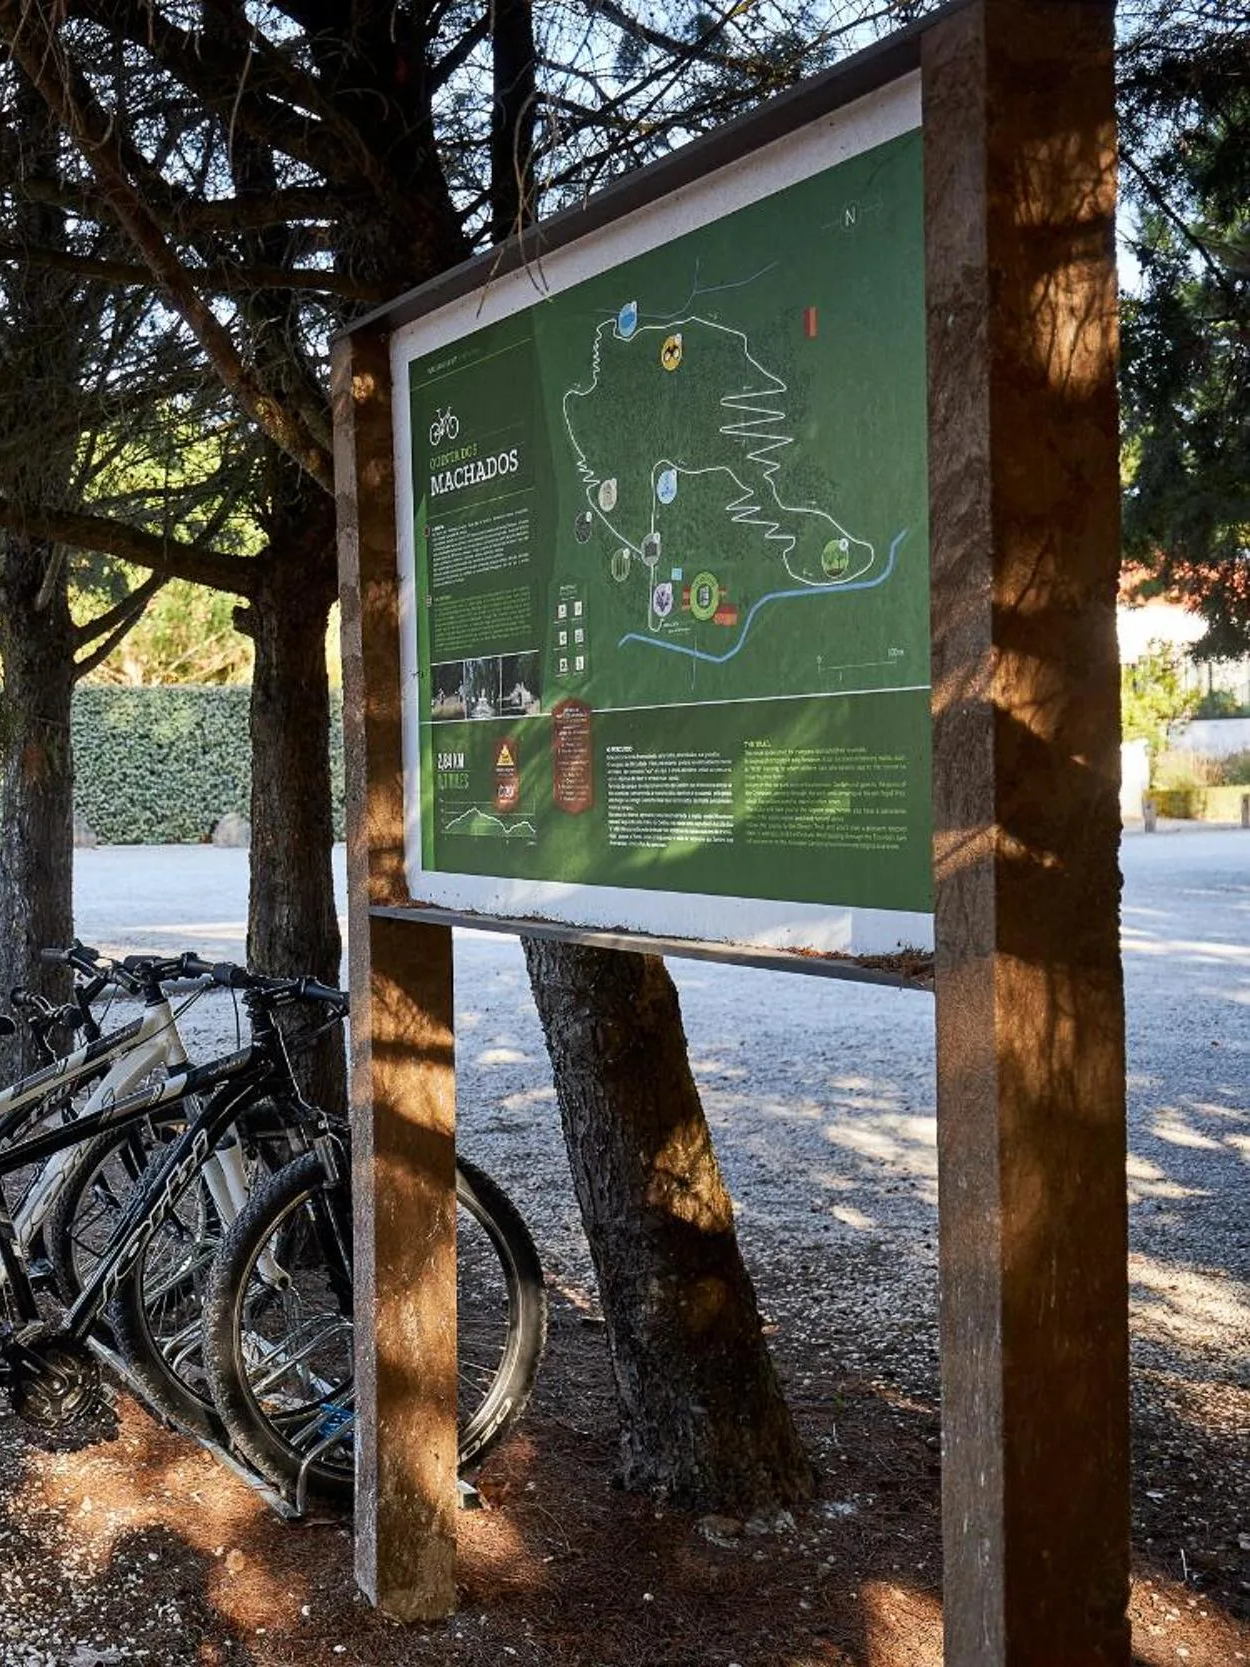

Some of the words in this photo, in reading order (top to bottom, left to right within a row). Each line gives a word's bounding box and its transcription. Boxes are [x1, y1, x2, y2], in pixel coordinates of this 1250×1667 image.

[845, 207, 856, 226] N
[430, 449, 519, 496] MACHADOS
[461, 1397, 513, 1463] OZO
